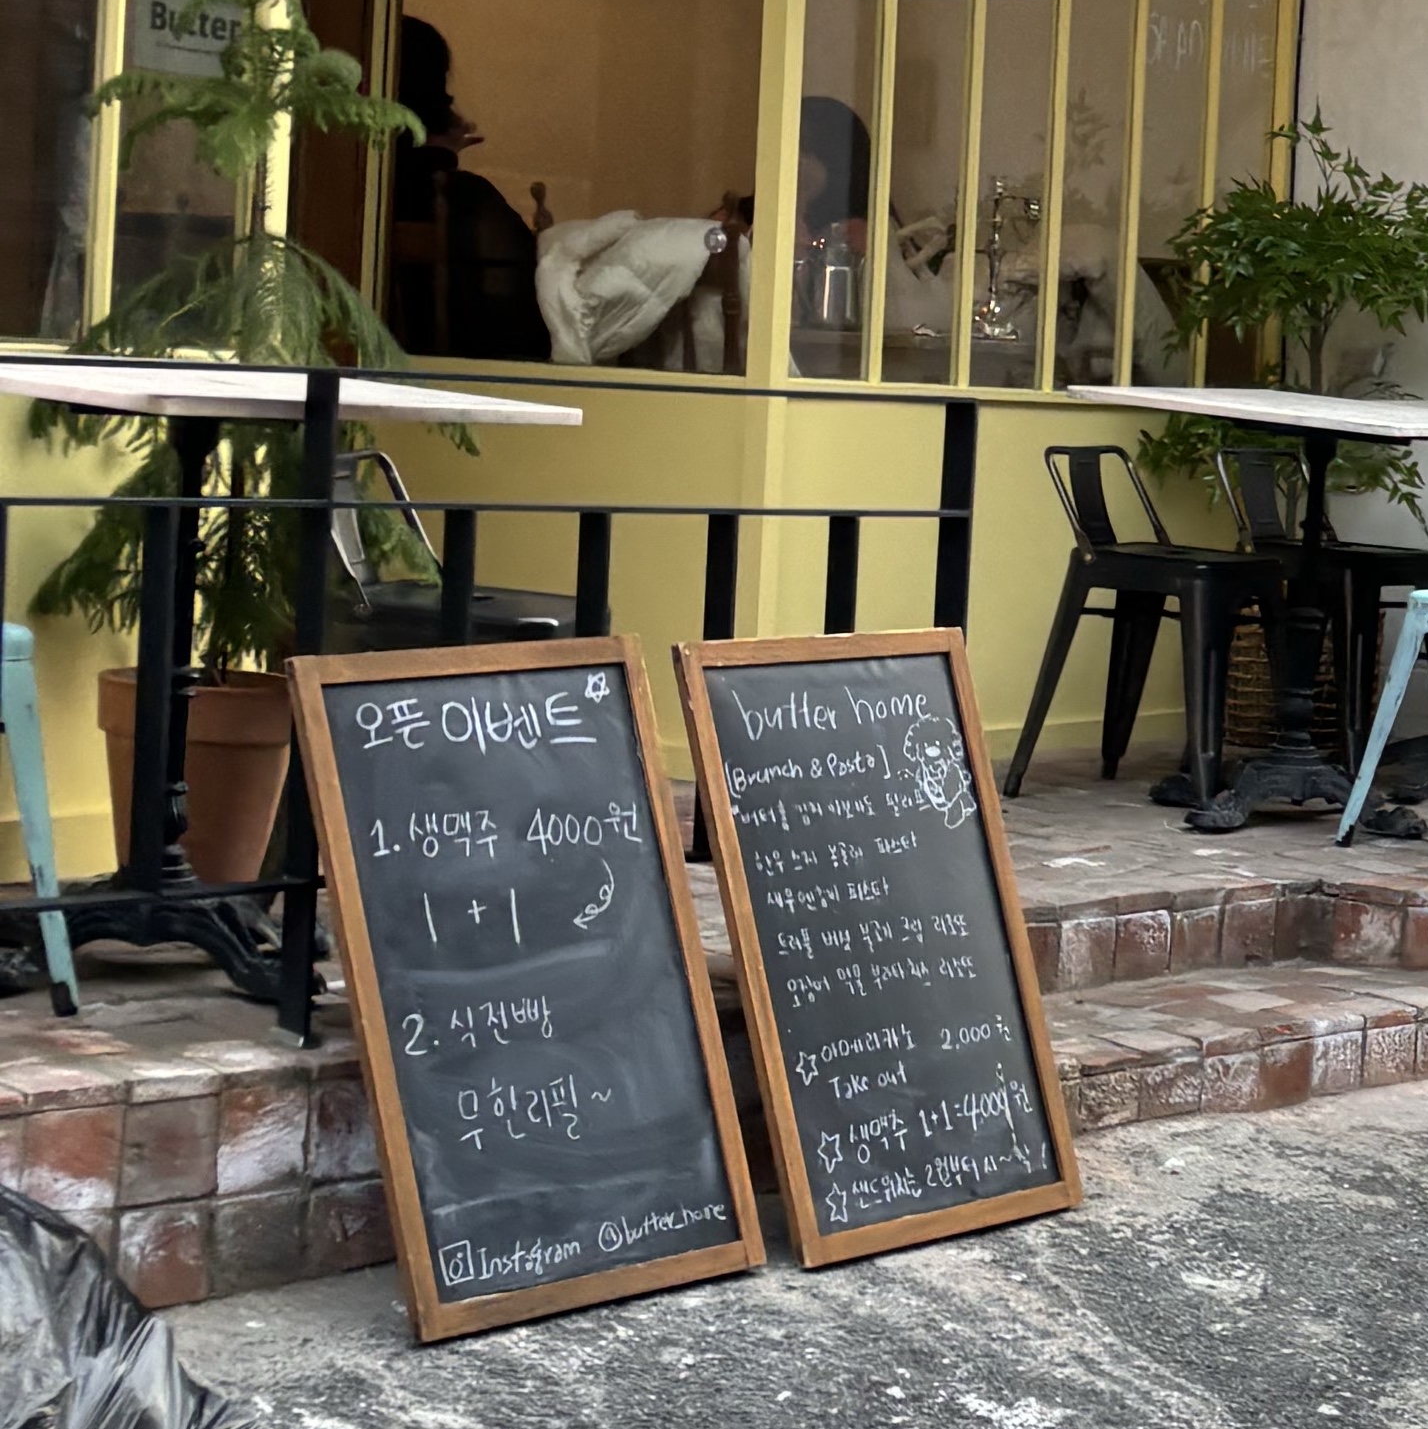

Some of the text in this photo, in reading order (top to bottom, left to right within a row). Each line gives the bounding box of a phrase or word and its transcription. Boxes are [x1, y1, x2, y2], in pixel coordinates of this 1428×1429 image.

[150, 0, 242, 42] Buter
[356, 692, 597, 755] 오픈 이벤트
[732, 686, 931, 740] butter home
[810, 759, 822, 778] &
[371, 802, 643, 858] 1. 생맥주 4000원
[874, 831, 917, 854] 파스타
[403, 996, 553, 1055] 2. 식전빵
[821, 1023, 915, 1062] 아메리카노
[877, 1060, 907, 1087] out
[849, 1109, 908, 1164] 생맥주
[477, 1238, 581, 1280] Instagram
